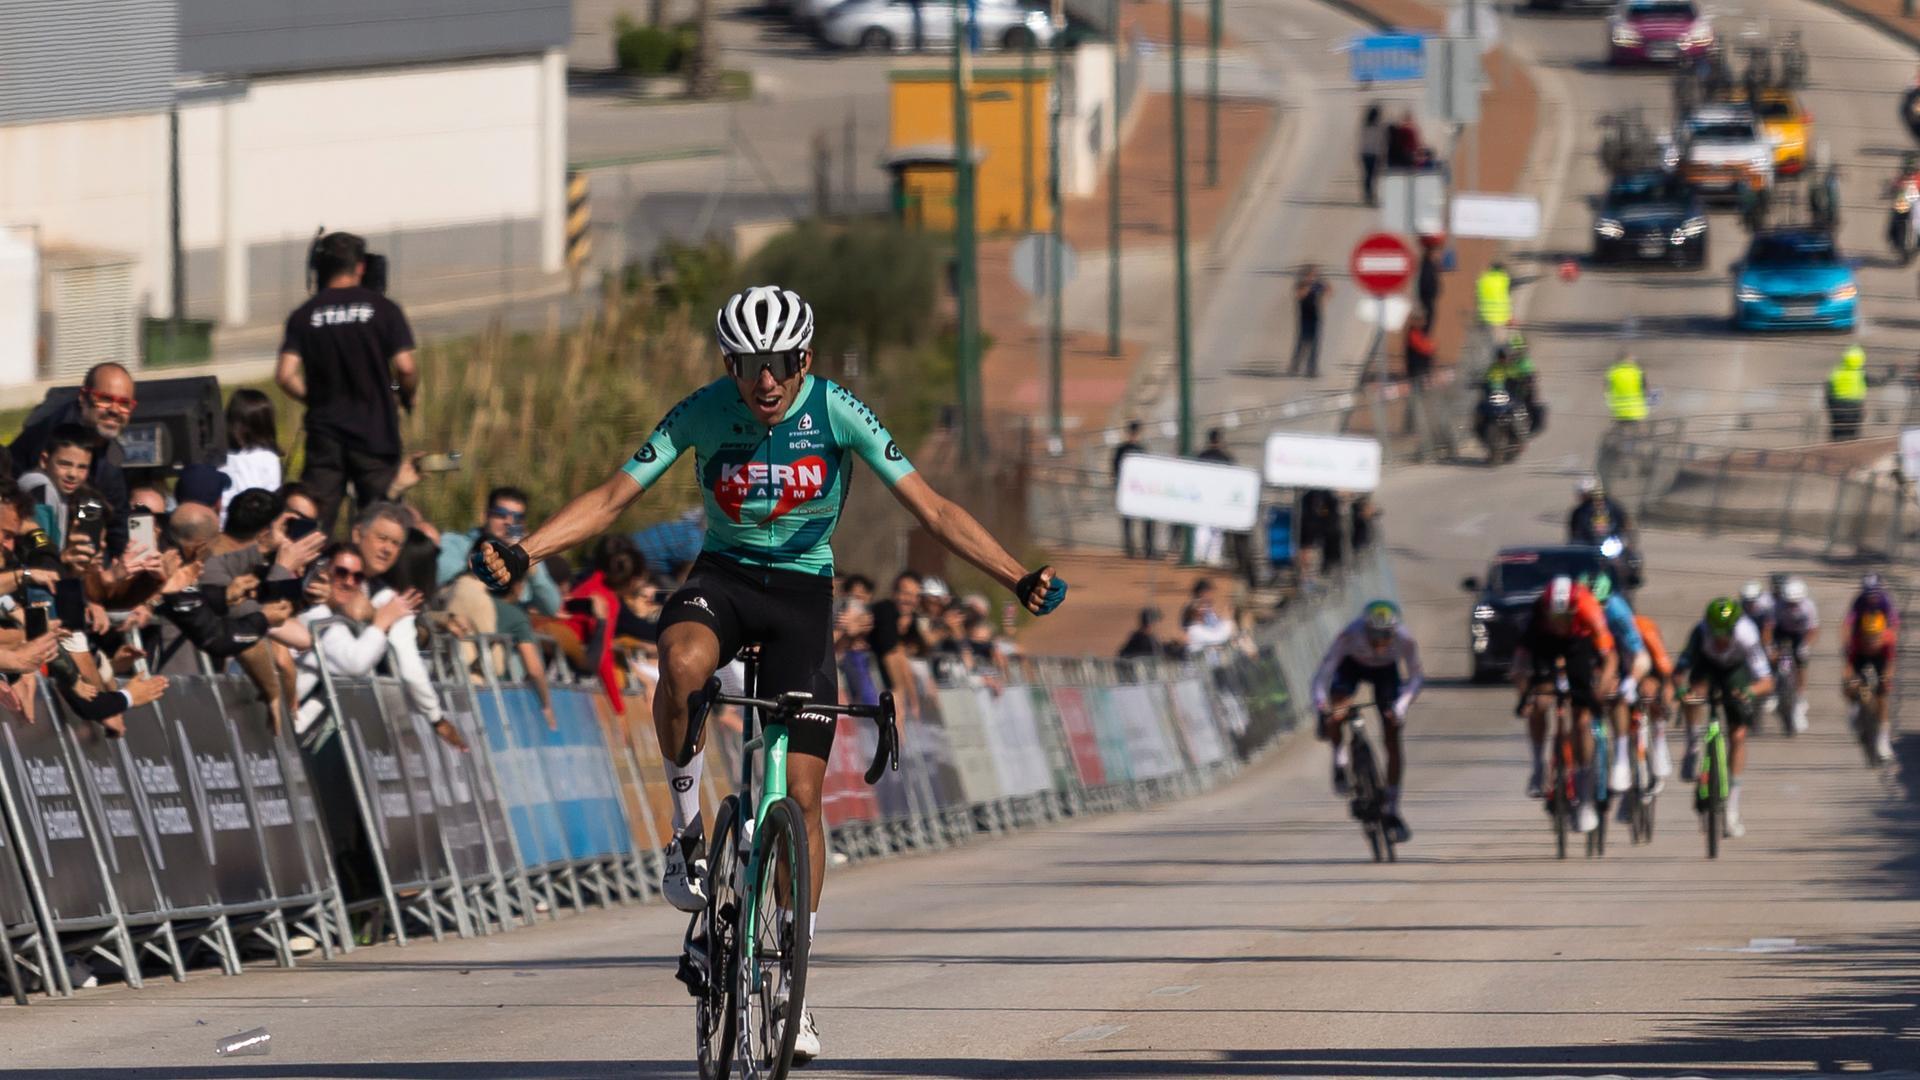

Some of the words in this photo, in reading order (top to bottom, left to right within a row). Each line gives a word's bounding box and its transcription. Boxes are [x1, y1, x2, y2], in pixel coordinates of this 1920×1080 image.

[311, 304, 374, 327] STAFF
[832, 388, 878, 435] PHARMA
[789, 441, 807, 449] BCD
[721, 463, 823, 487] KERN
[721, 485, 824, 499] PHARMA
[795, 712, 833, 724] IANT
